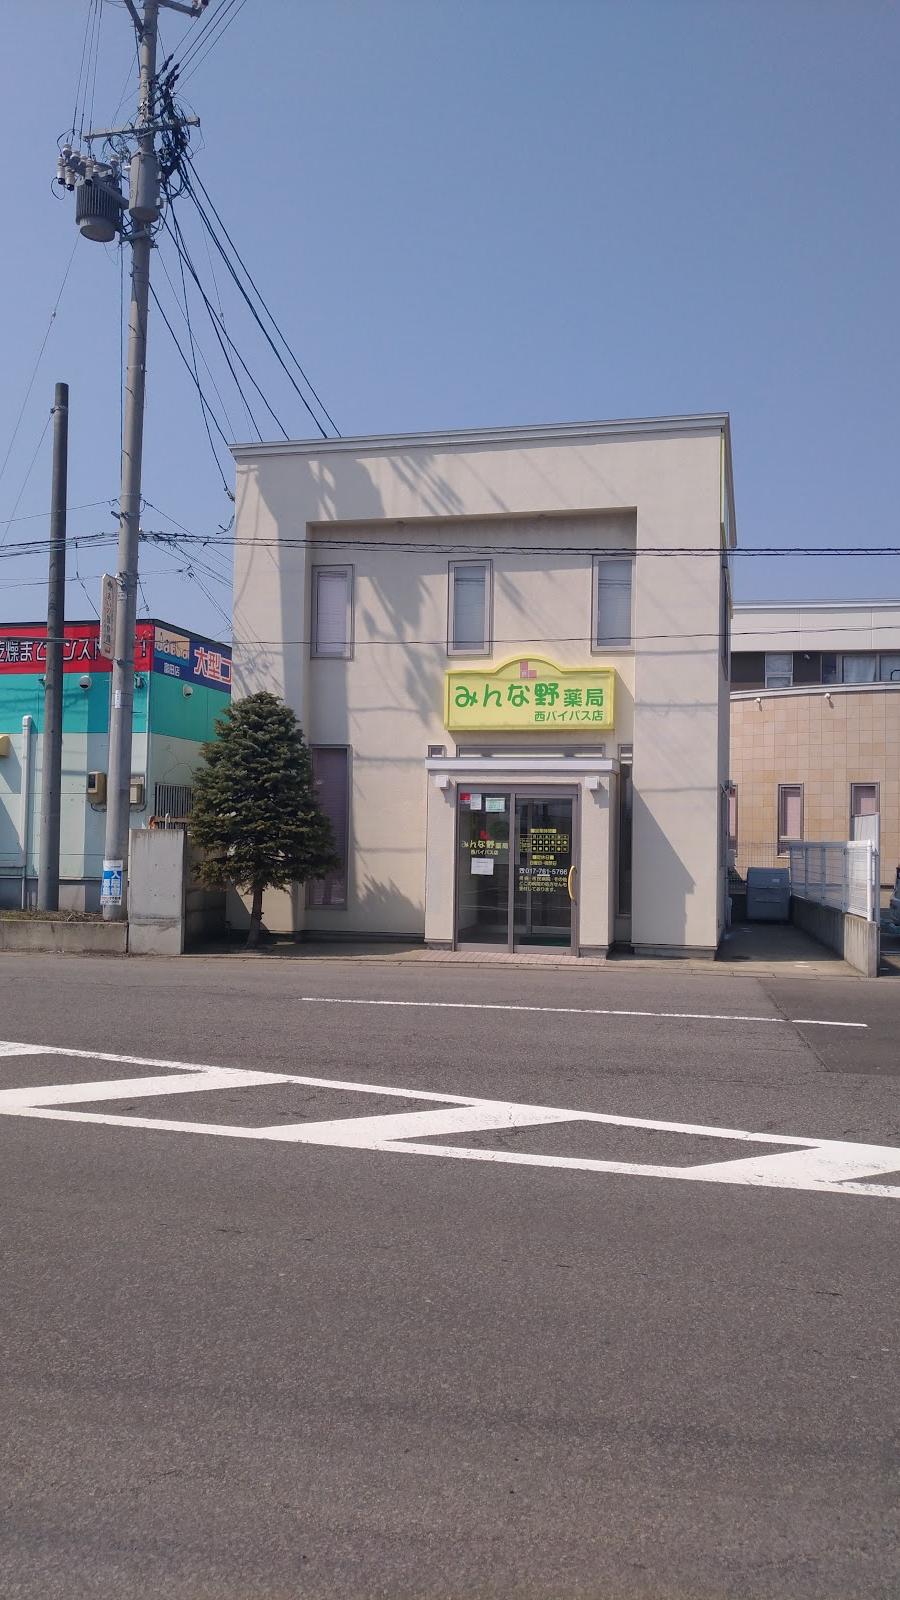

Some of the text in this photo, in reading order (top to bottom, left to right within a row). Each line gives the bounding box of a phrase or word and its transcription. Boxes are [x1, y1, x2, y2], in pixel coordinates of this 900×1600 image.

[455, 683, 604, 707] みんな野薬局
[534, 710, 604, 722] 西バイパス店
[461, 840, 508, 849] みんな野薬局
